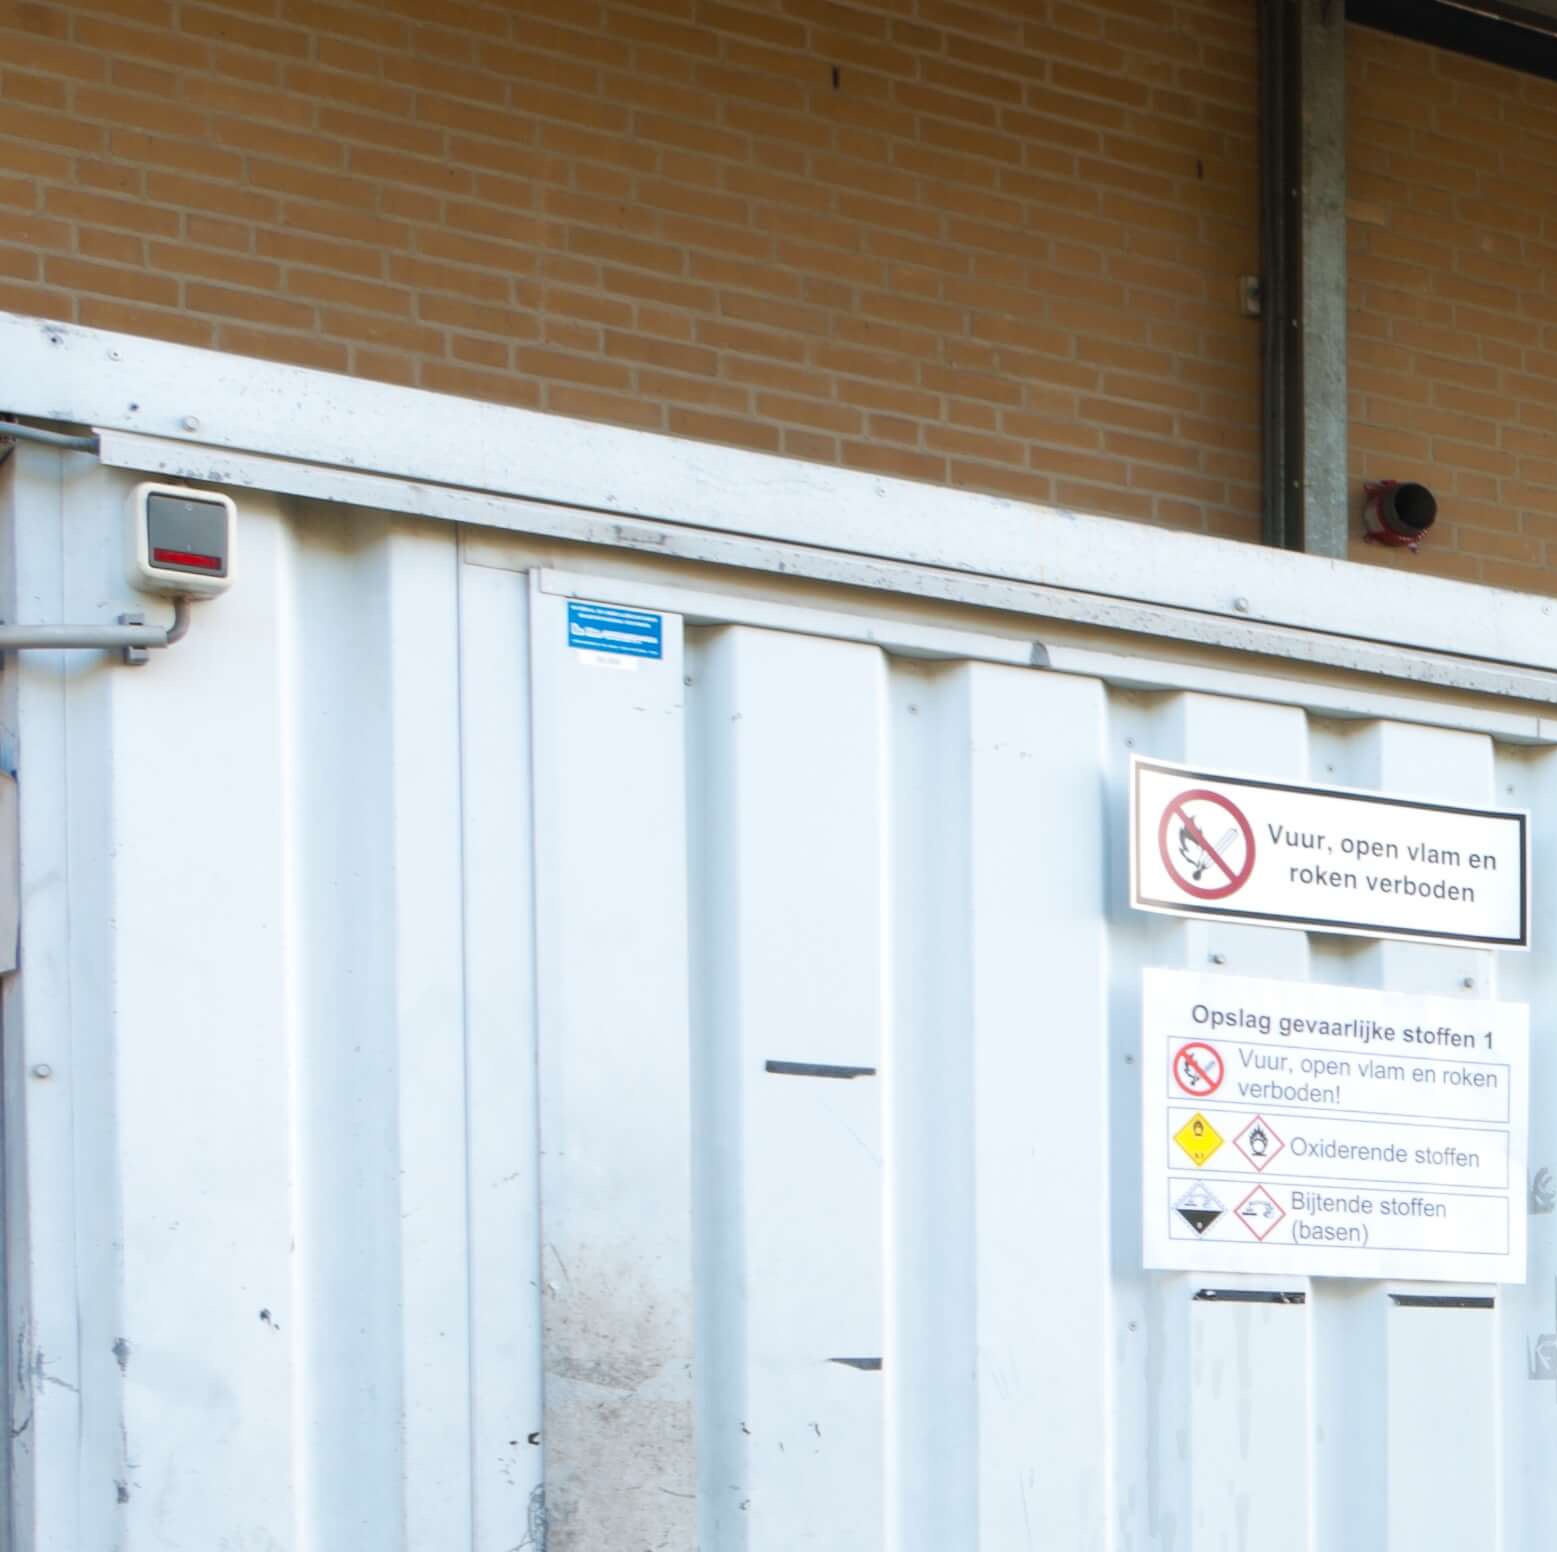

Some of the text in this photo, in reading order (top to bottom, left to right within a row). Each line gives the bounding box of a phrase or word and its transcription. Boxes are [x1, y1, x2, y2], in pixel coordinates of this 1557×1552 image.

[1268, 824, 1497, 870] Vuur, open vlam en
[1289, 865, 1475, 902] roken verboden
[1191, 1005, 1493, 1049] Opslag gevaarlijke stoffen 1
[1239, 1047, 1497, 1088] Vuur, open vlam en roken
[1238, 1079, 1340, 1104] verboden!
[1290, 1137, 1480, 1168] Oxiderende stoffen
[1291, 1191, 1447, 1218] Bijtende stoffen
[1292, 1219, 1369, 1246] (basen)
